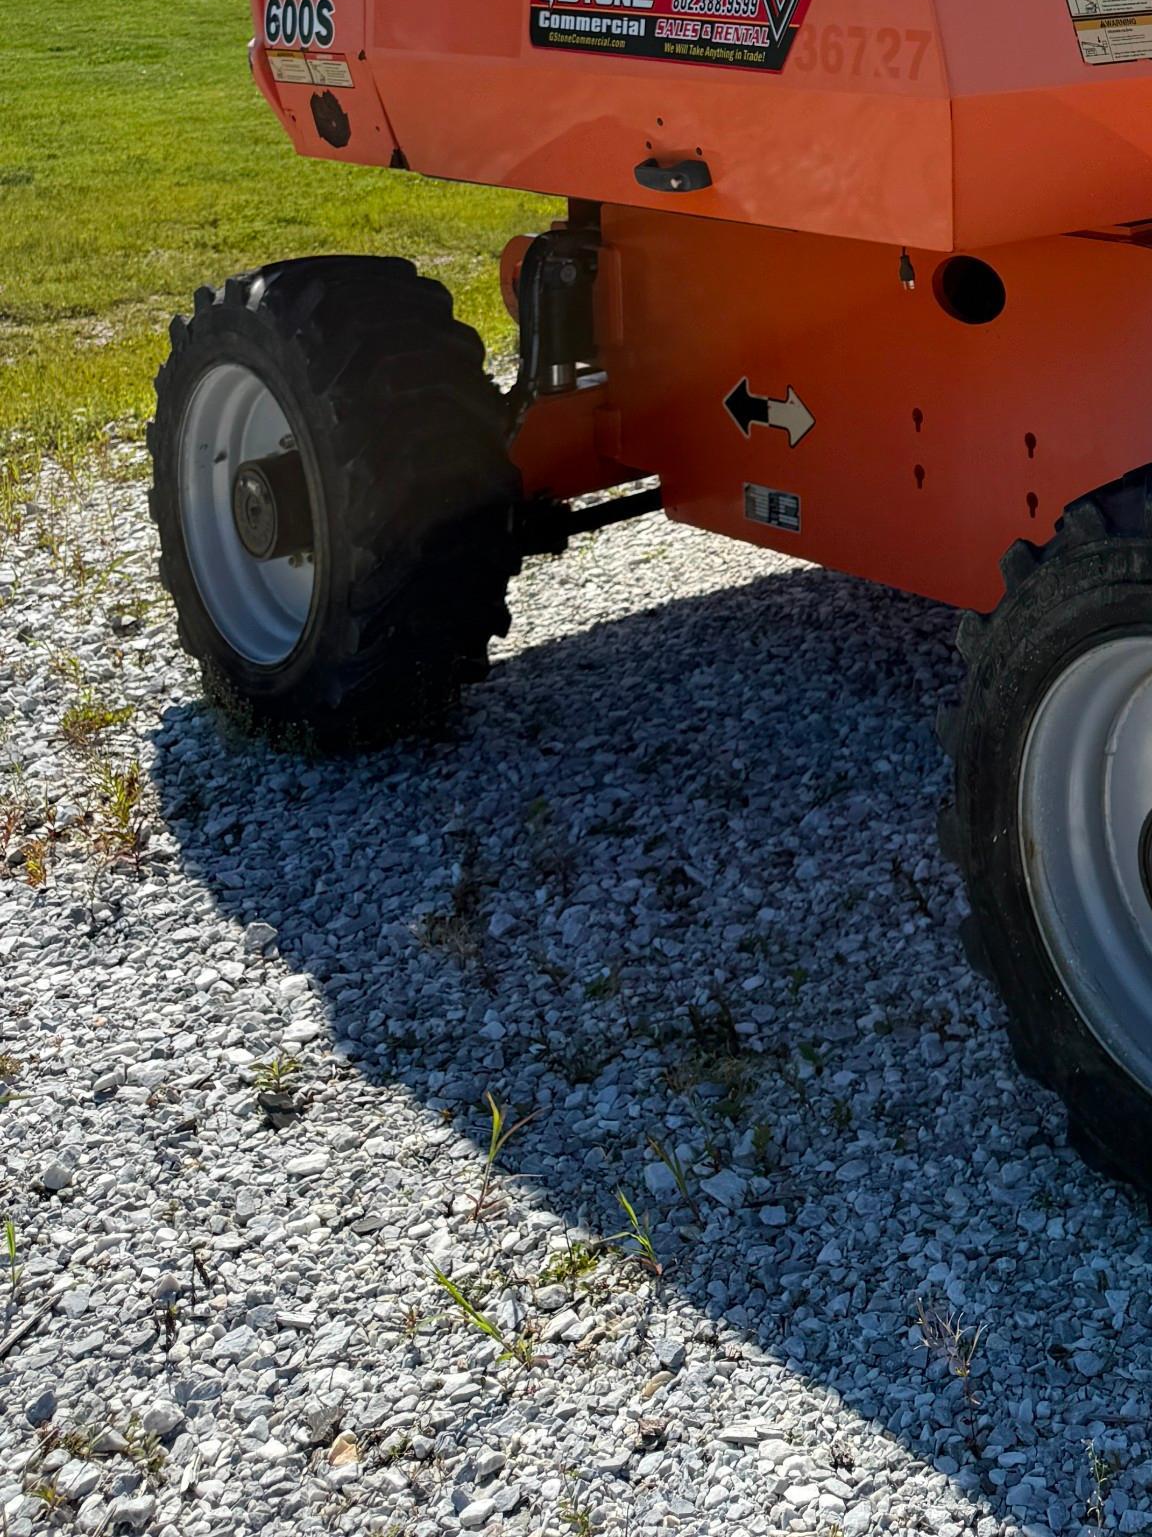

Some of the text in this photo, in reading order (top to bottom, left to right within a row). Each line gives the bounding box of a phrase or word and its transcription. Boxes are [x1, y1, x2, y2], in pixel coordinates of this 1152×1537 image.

[538, 10, 646, 37] Commercial
[655, 18, 770, 47] SALES & RENTAL
[1105, 17, 1137, 28] WARNING
[548, 31, 626, 49] GStoneCommercial.com
[664, 42, 766, 62] We Will Take Anything in Trade!
